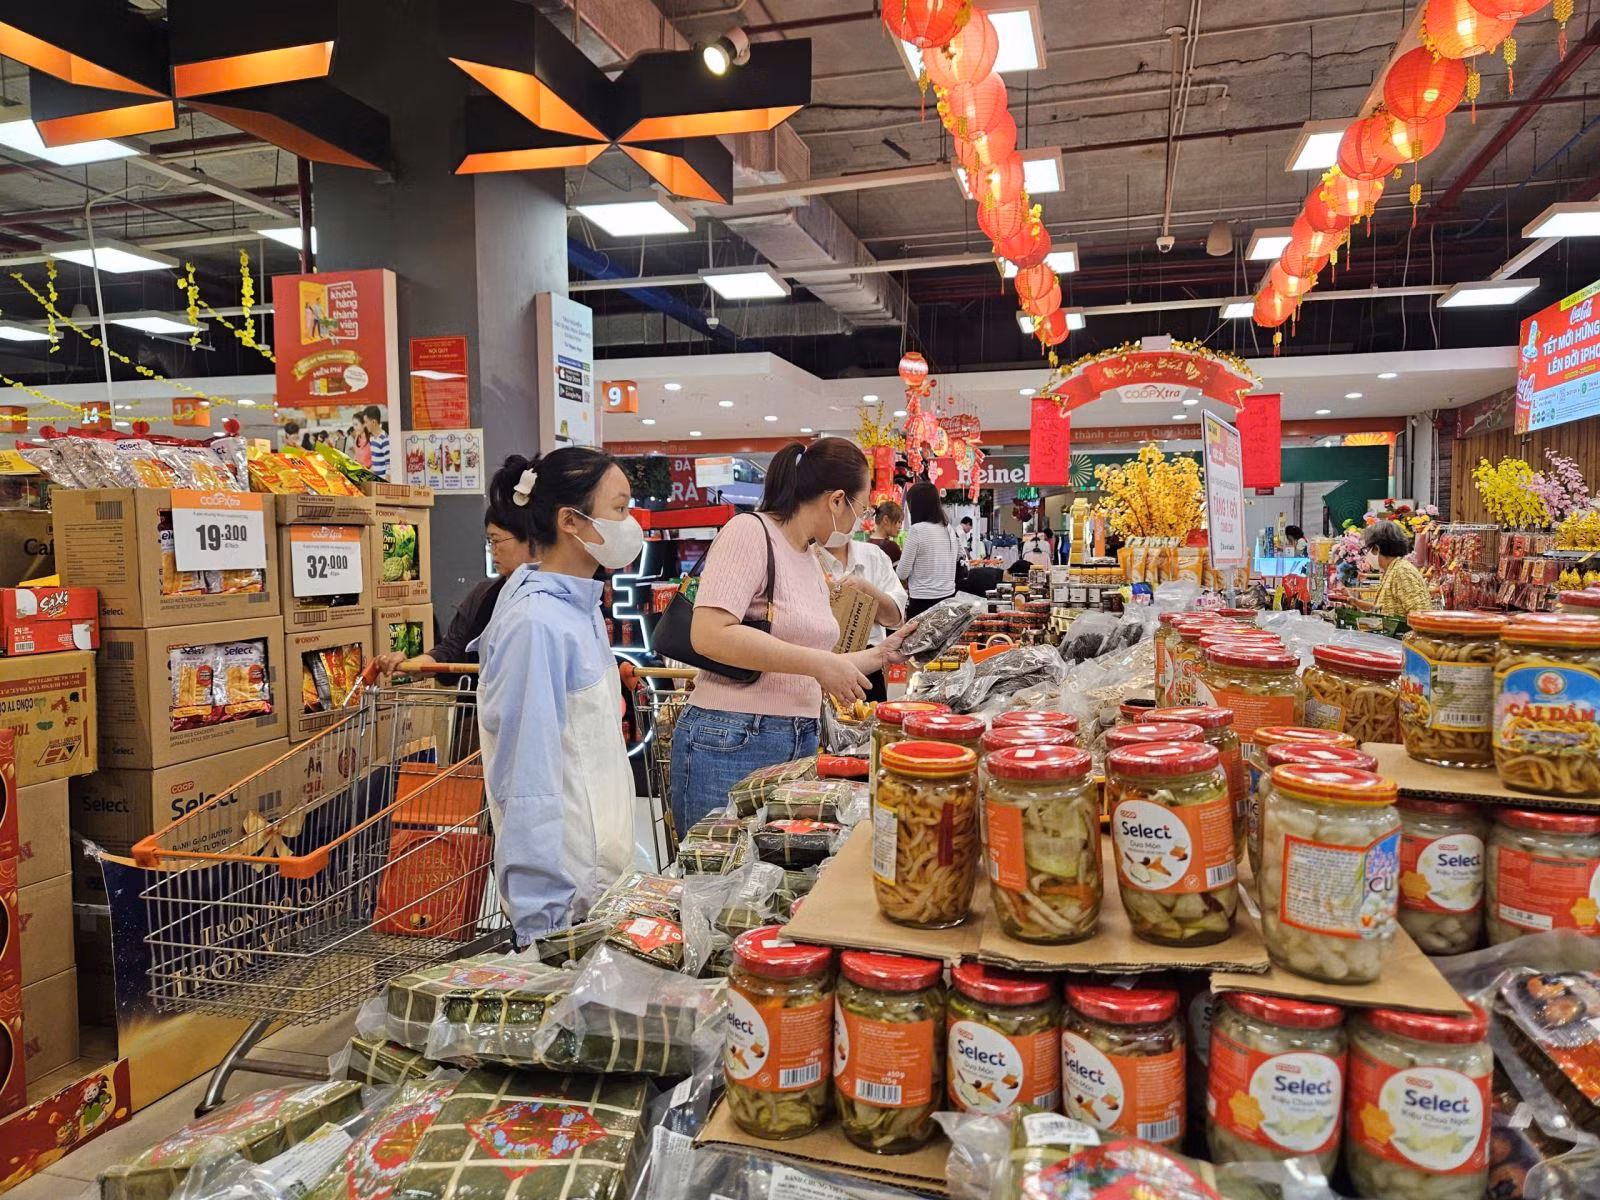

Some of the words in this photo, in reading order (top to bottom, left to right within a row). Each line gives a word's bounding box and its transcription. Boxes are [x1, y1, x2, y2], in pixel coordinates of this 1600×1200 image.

[333, 309, 358, 319] thành
[1543, 334, 1558, 356] TẾT
[1558, 330, 1574, 350] MỚI
[608, 386, 621, 406] 9
[82, 407, 98, 424] 14
[1074, 430, 1104, 440] thành
[1107, 428, 1130, 439] cảm
[1151, 427, 1176, 439] Quý
[171, 781, 194, 794] COOP
[83, 799, 130, 814] Select
[171, 784, 238, 821] Select
[1121, 820, 1172, 839] Select
[1438, 853, 1481, 867] Select
[727, 1012, 754, 1035] elect
[957, 1039, 1006, 1067] Select
[1064, 1050, 1105, 1085] Select
[1274, 1075, 1332, 1095] Select
[1404, 1089, 1470, 1113] Select
